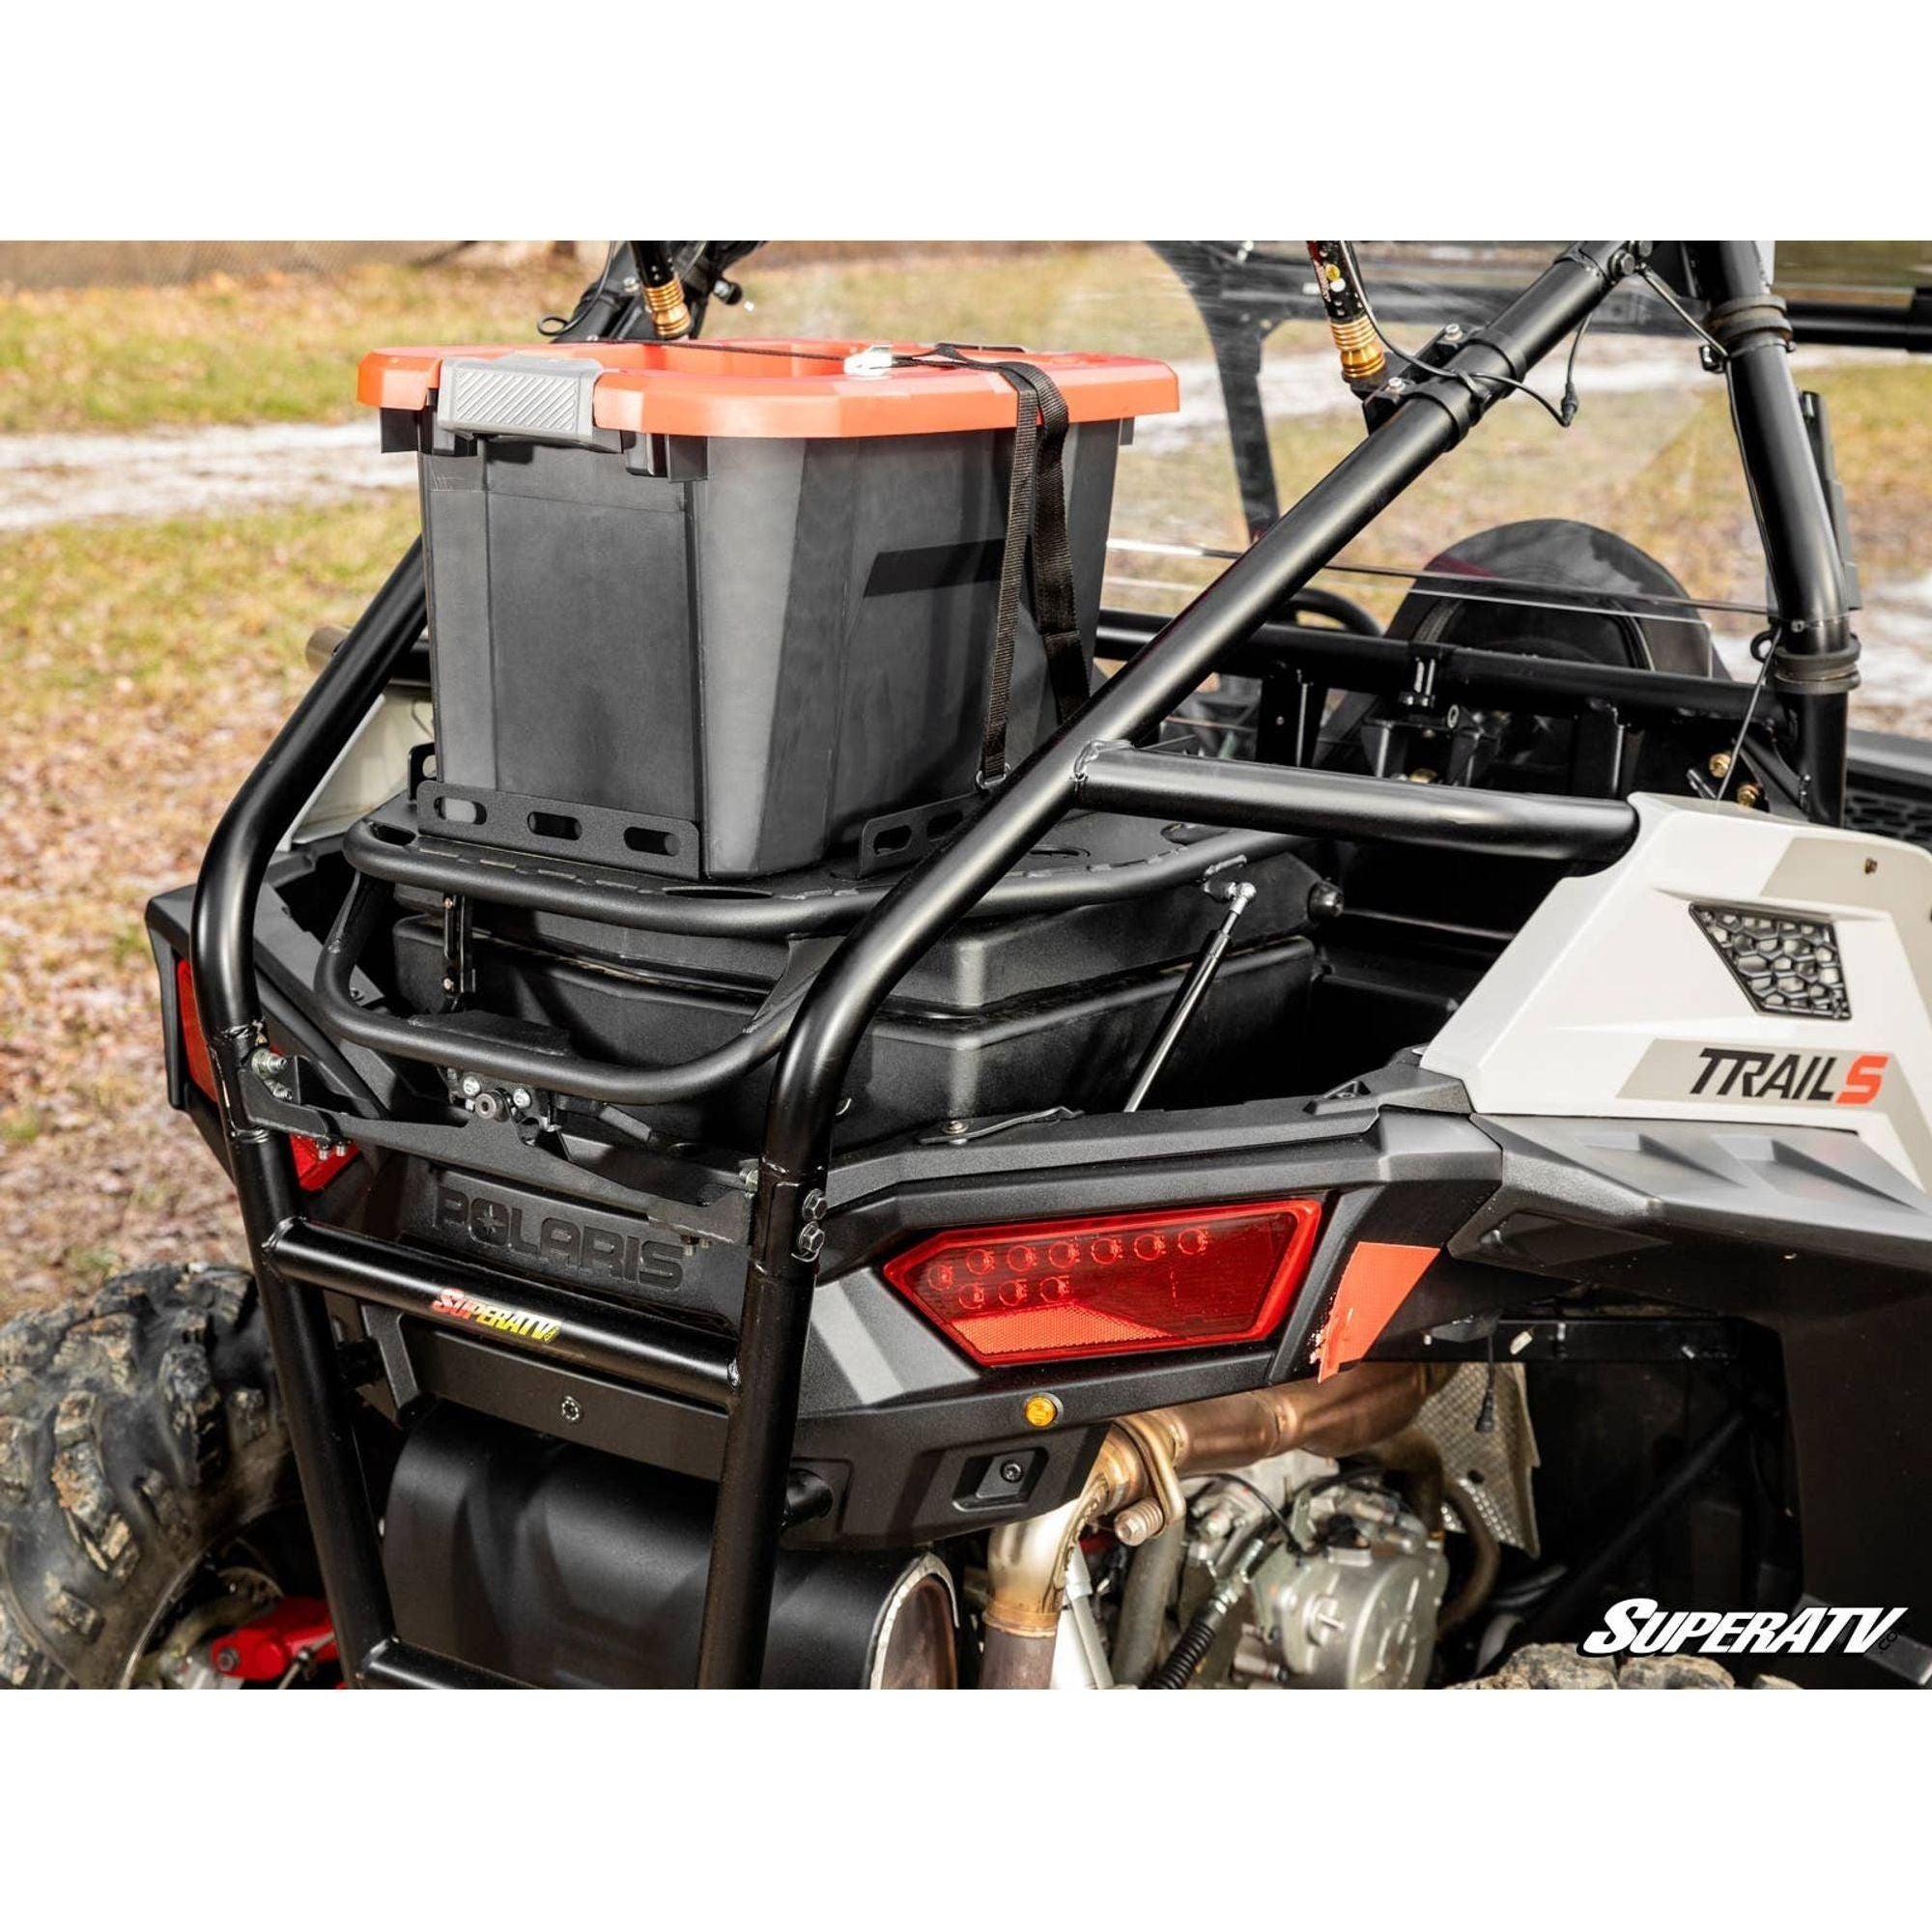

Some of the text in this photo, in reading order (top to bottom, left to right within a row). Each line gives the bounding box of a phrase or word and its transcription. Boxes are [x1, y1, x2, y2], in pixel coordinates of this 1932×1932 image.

[1690, 1047, 1837, 1101] TRAIL
[434, 1187, 685, 1292] POLARIS
[432, 1289, 562, 1340] SUPERATV
